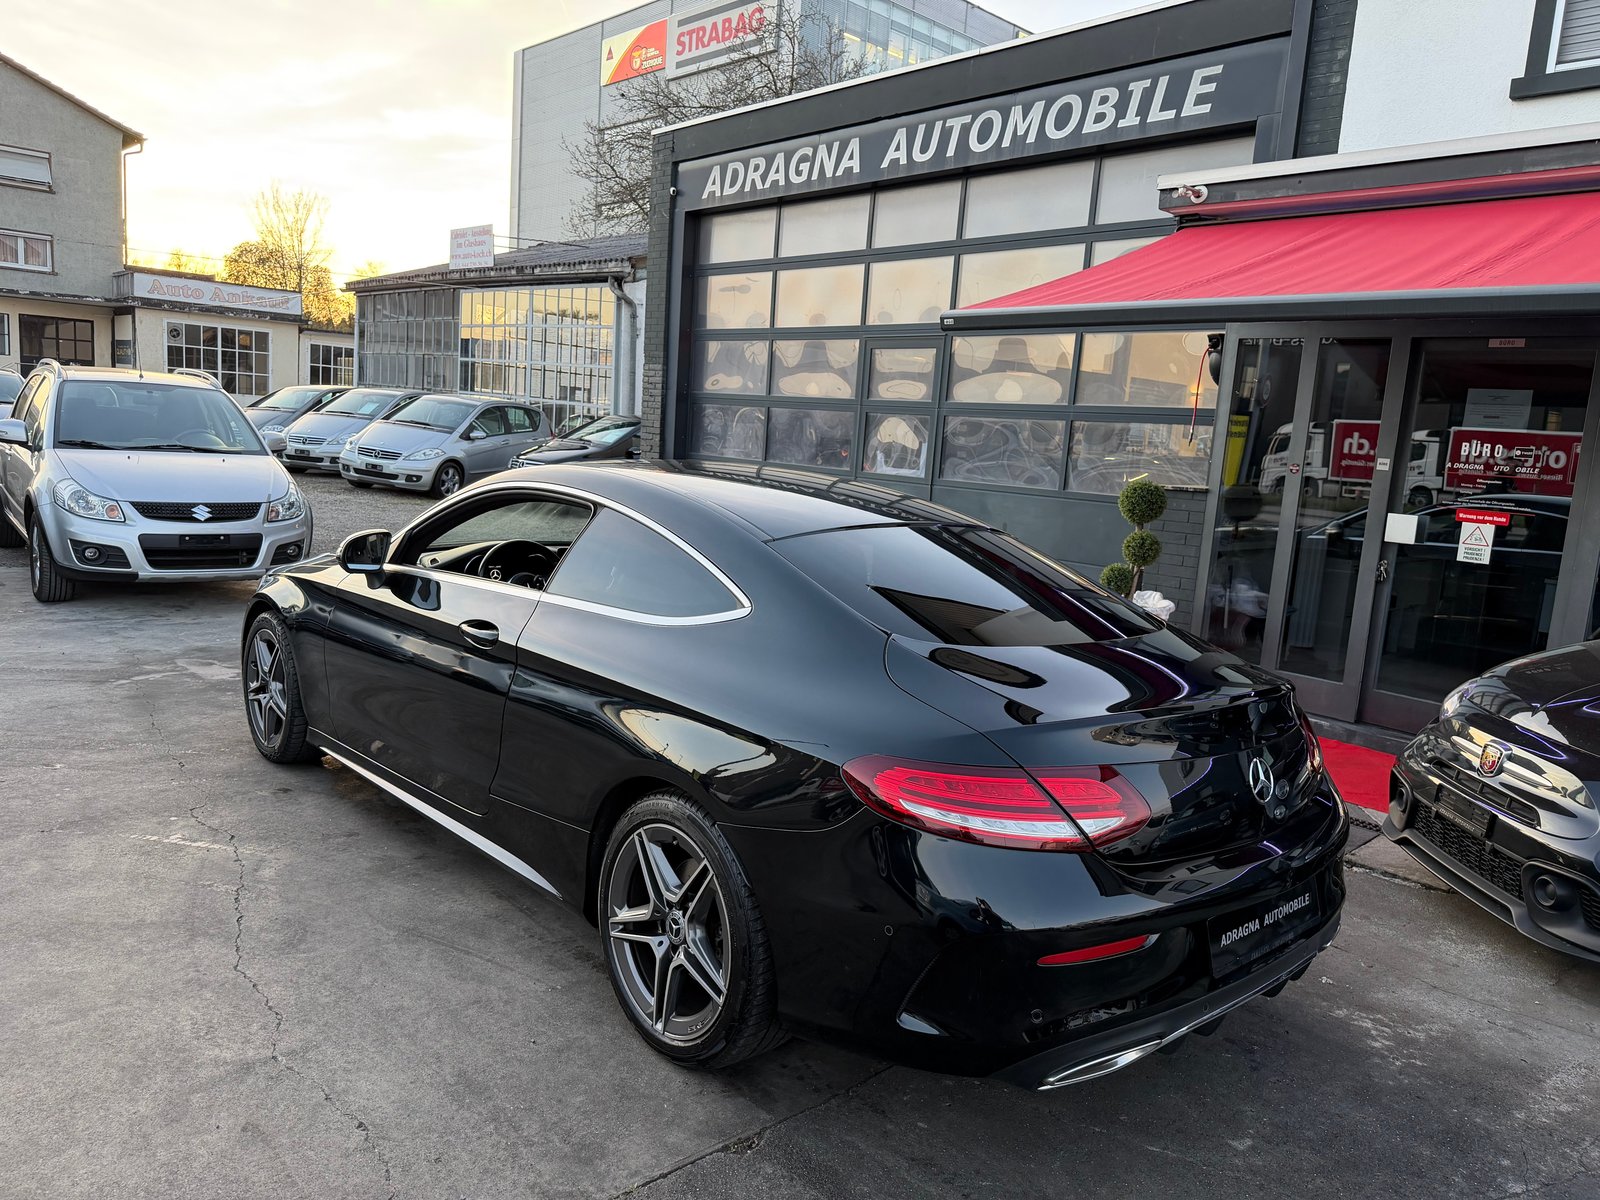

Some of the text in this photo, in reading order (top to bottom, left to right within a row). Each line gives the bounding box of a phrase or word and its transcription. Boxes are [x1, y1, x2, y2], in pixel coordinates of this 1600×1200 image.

[676, 7, 764, 56] STRABAG
[702, 64, 1224, 199] ADRAGNA AUTOMOBILE
[148, 278, 205, 299] Auto
[1461, 440, 1503, 457] BÜRO
[1220, 918, 1260, 948] ADRAGNA
[1264, 893, 1310, 926] AUTOMOBILE
